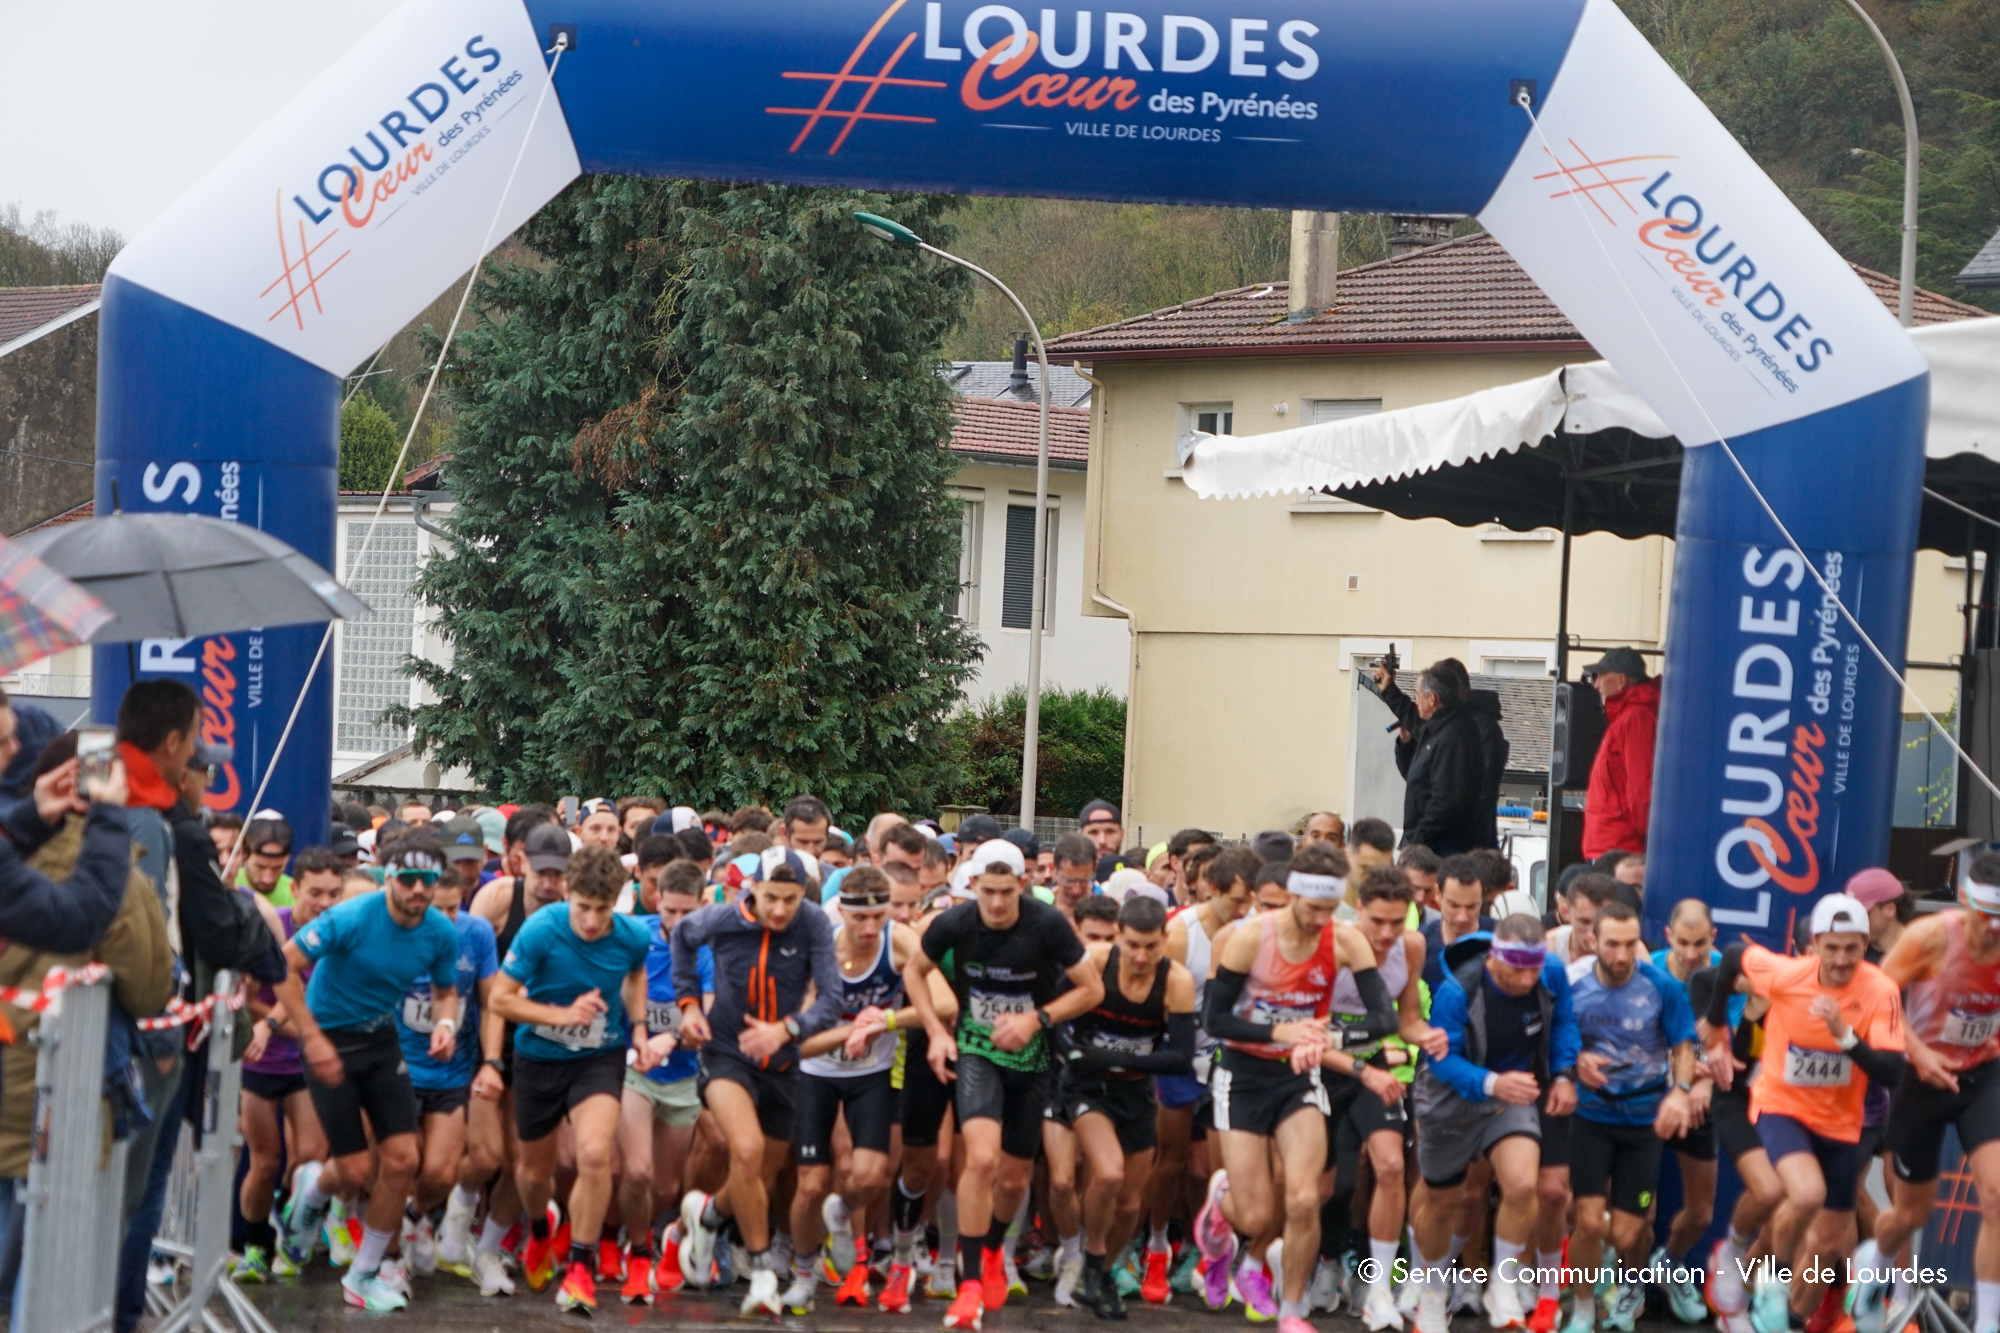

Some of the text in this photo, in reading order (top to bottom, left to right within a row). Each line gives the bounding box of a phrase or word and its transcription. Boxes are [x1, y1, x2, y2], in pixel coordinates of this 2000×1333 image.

[923, 1, 1321, 81] LOURDES
[960, 30, 1319, 121] Cœur des Pyrénées
[292, 35, 502, 225] LOURDES
[341, 69, 524, 229] Cœur des Pyrénées
[411, 125, 491, 196] VILLE DE LOURDES
[1065, 121, 1222, 143] VILLE DE LOURDES
[1638, 217, 1800, 395] Cœur des Pyrénées
[1640, 170, 1834, 374] LOURDES
[1670, 285, 1743, 363] VILLE DE LOURDES
[248, 635, 264, 660] DE
[248, 662, 264, 709] VILLE
[1712, 545, 1806, 928] LOURDES
[1744, 550, 1844, 895] Cœur des Pyrénées
[1834, 643, 1861, 795] VILLE DE LOURDES
[1793, 1057, 1842, 1079] 2444
